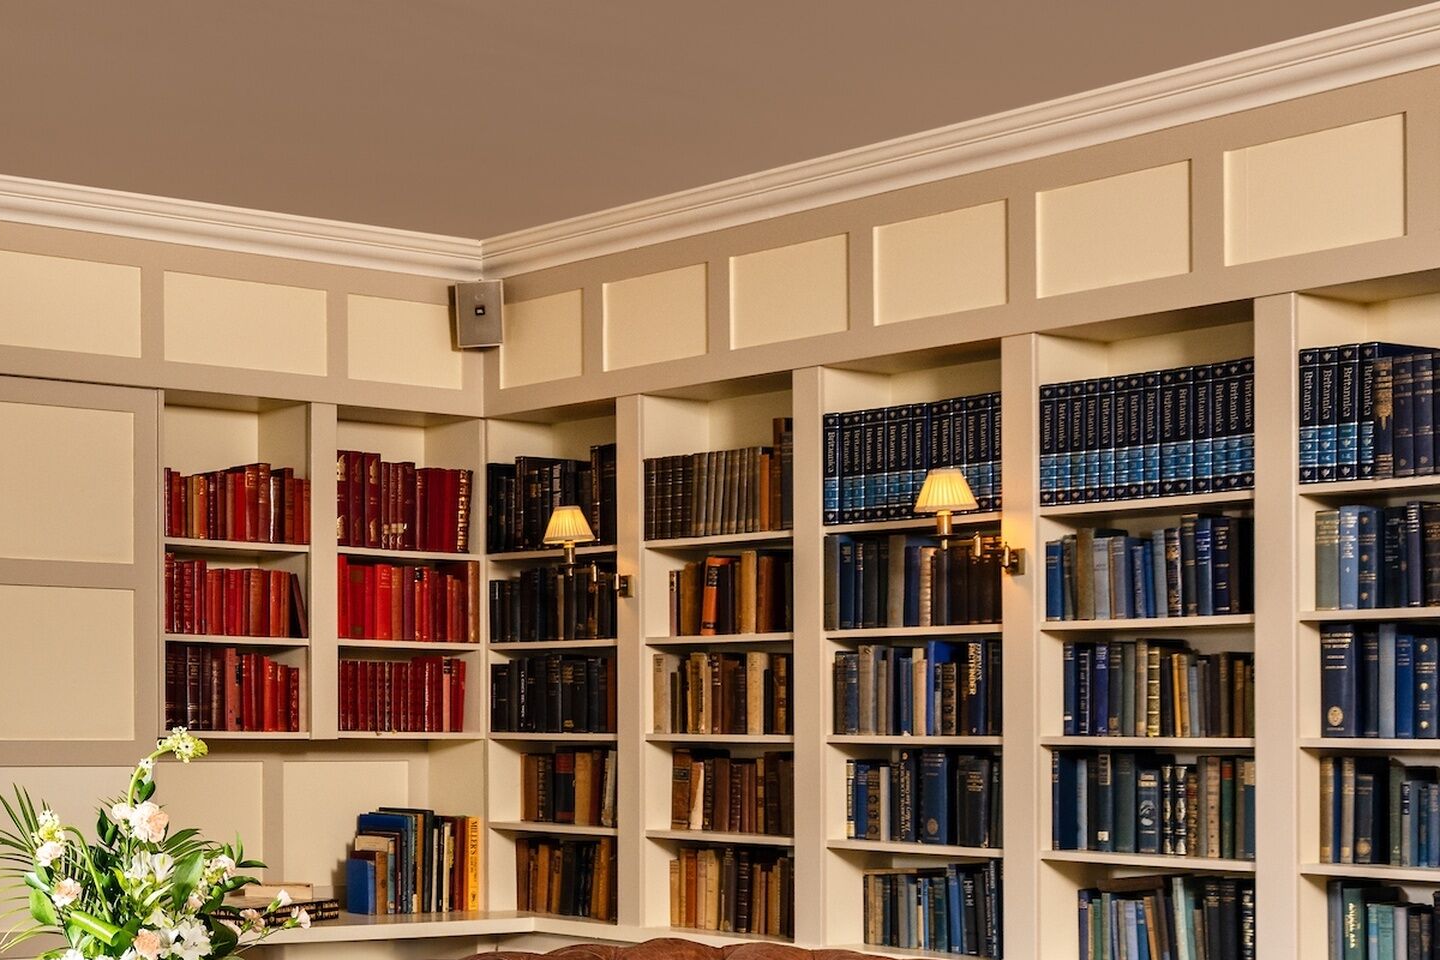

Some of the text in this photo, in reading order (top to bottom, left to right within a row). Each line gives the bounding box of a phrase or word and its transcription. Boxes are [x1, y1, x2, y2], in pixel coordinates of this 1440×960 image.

[1304, 371, 1313, 421] Britannica
[1323, 369, 1332, 420] Britannica
[1343, 367, 1352, 417] Britannica
[1364, 365, 1373, 416] Britannica
